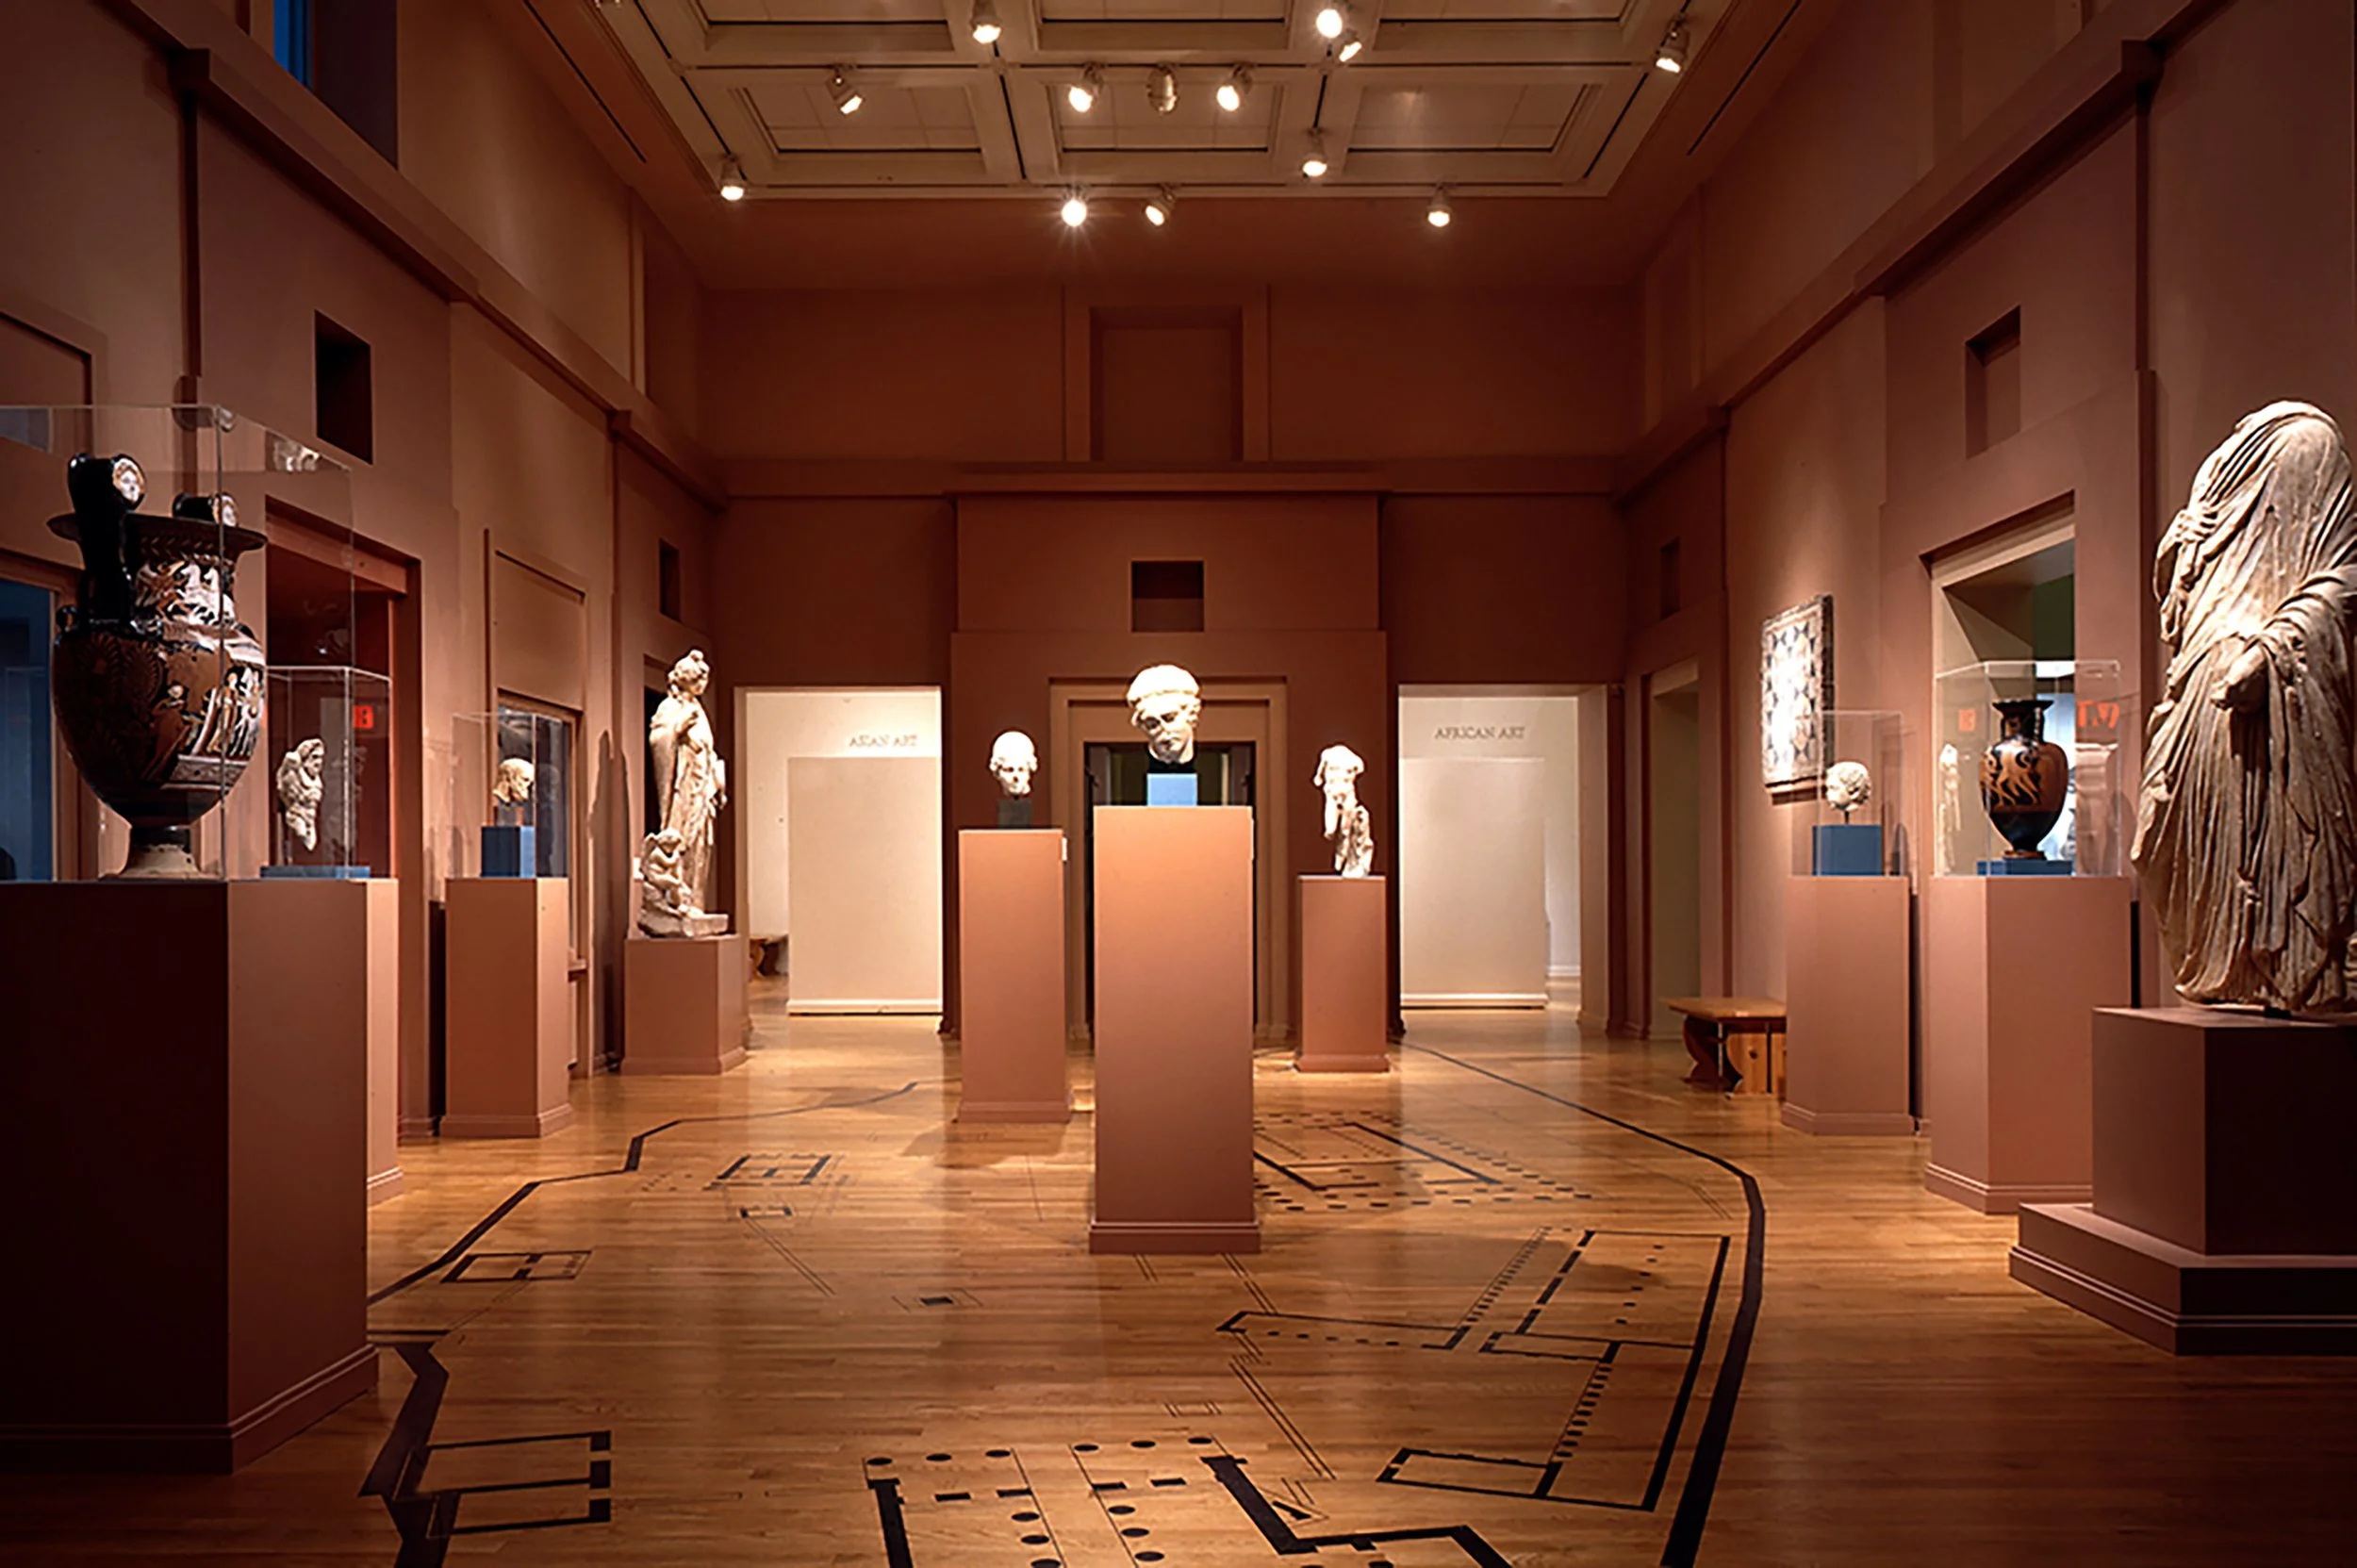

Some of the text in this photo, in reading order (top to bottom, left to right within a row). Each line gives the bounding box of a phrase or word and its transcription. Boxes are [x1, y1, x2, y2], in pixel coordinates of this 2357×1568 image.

[1434, 726, 1525, 739] AFRICAN ART
[849, 734, 917, 747] ASIAN ART
